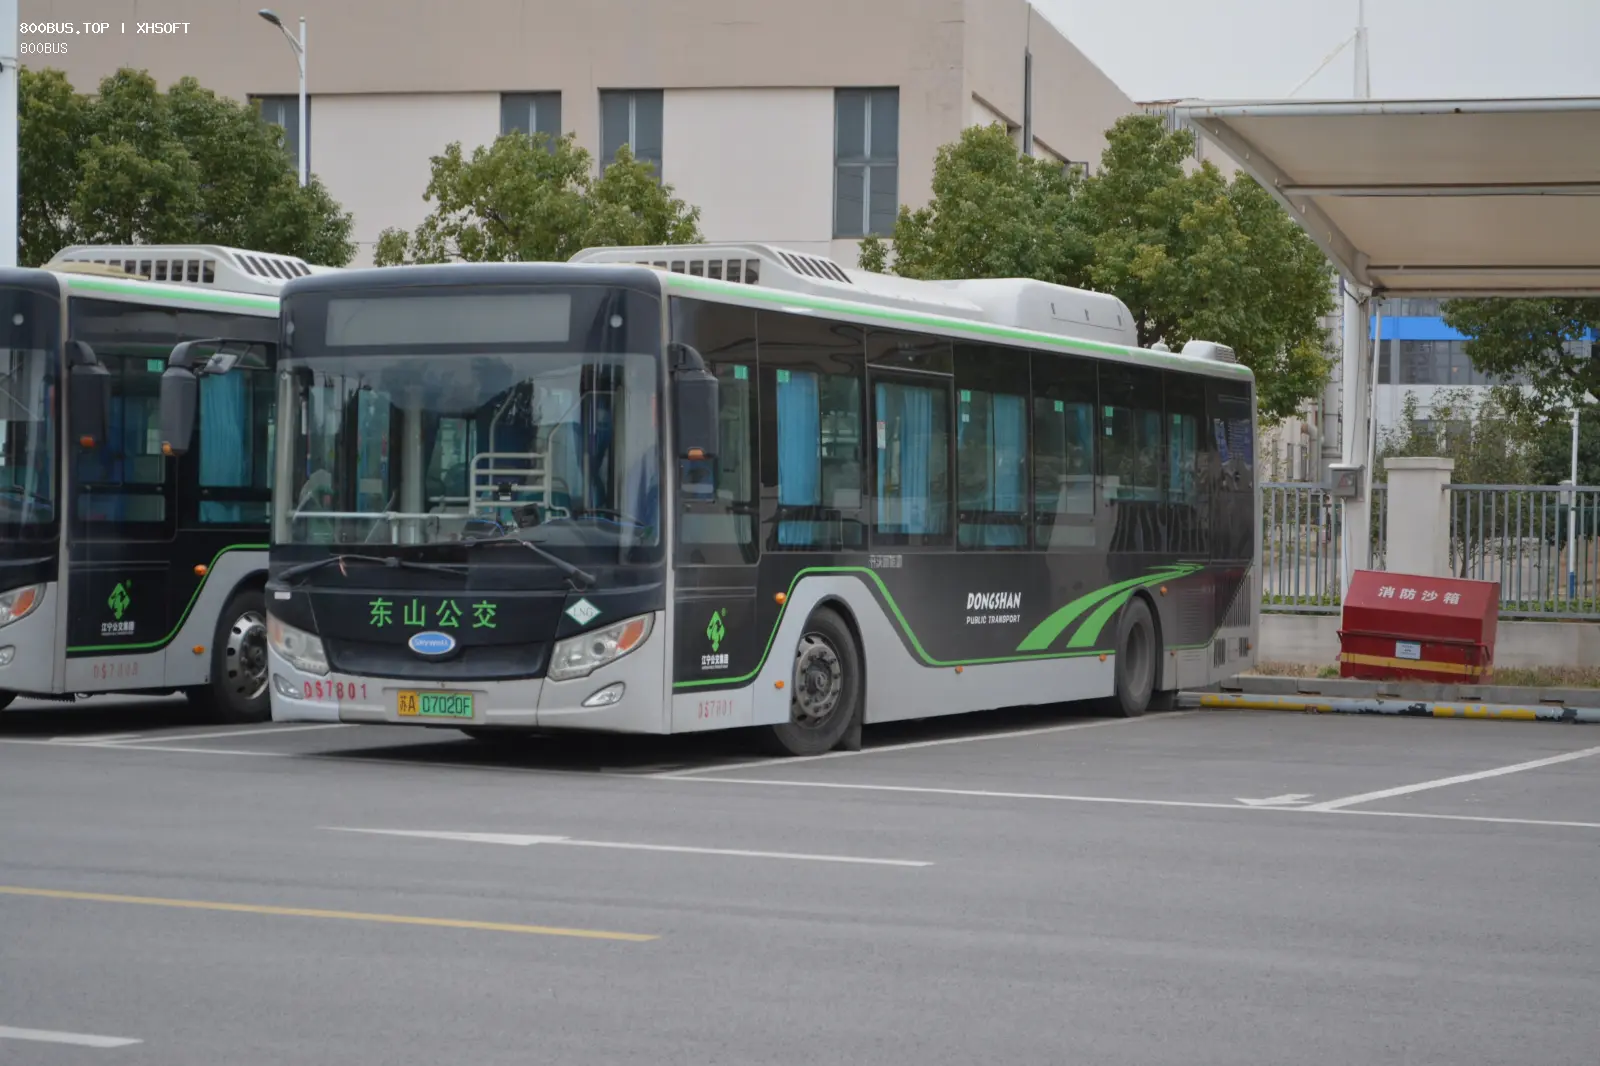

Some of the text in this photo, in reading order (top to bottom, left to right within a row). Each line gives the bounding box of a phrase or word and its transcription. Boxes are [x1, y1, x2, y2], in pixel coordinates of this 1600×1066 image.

[966, 591, 1022, 610] DONGSHAN
[1378, 585, 1462, 605] 消防沙箱
[369, 597, 497, 628] 东山公交
[966, 614, 1021, 625] PUBLIC TRANSPORT
[304, 680, 367, 700] DS7801
